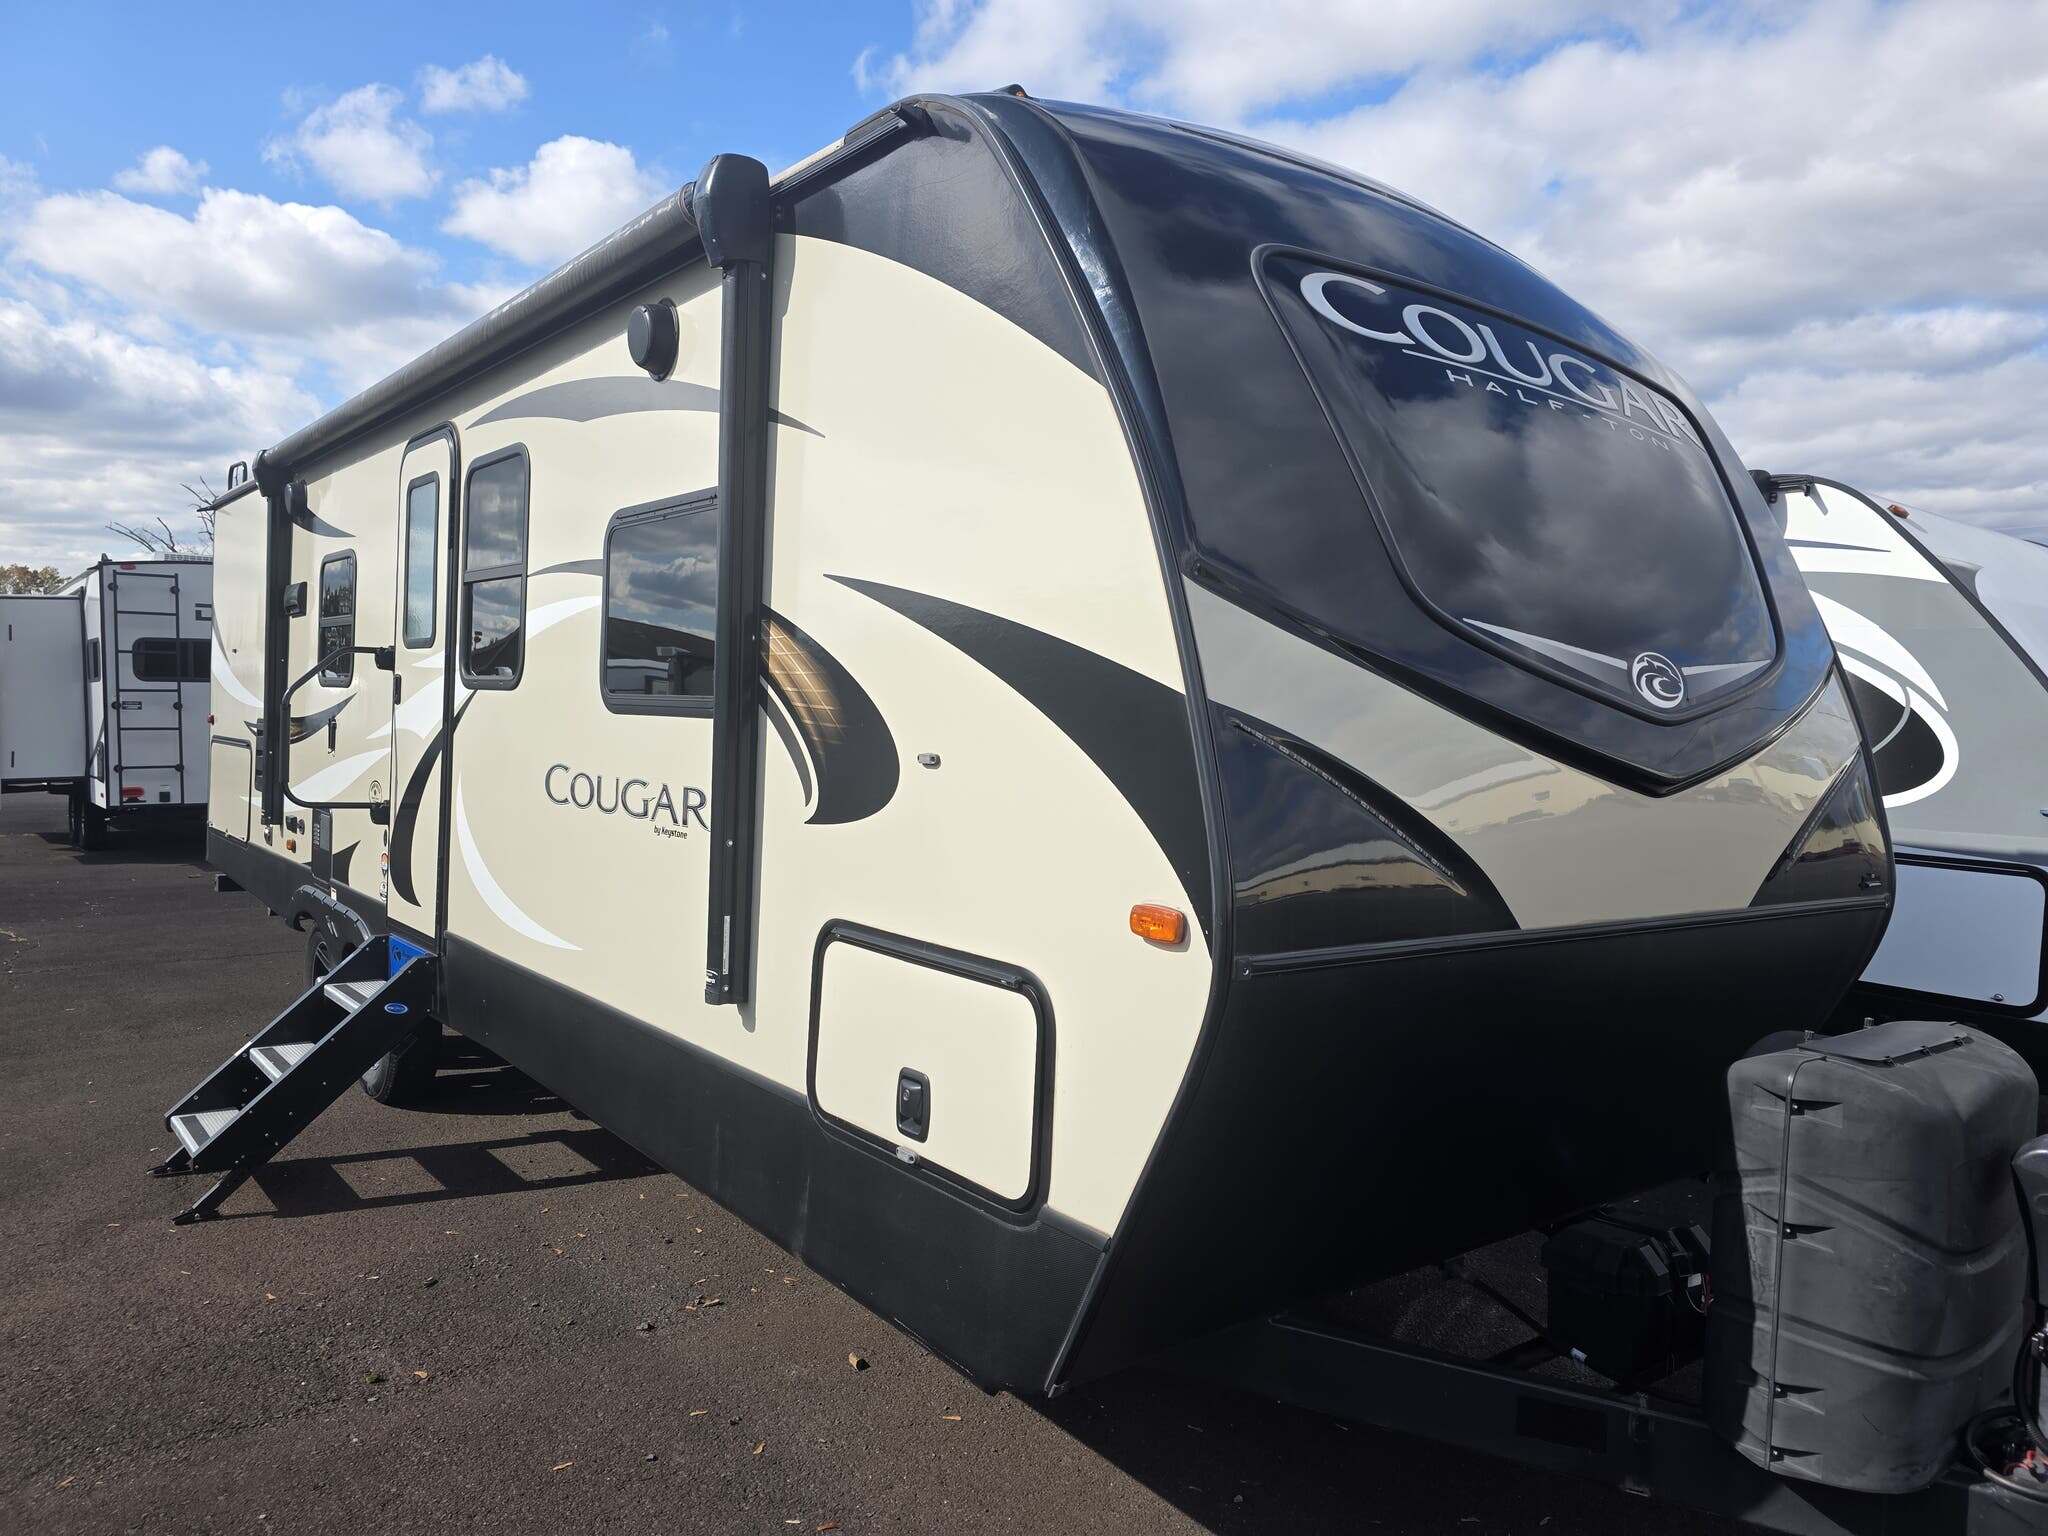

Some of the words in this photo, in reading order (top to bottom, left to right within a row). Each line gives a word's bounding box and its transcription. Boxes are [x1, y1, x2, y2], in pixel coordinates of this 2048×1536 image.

[1300, 272, 1706, 452] COUGAR
[545, 763, 711, 832] COUGAR
[653, 825, 661, 836] by
[661, 826, 688, 839] Keystone
